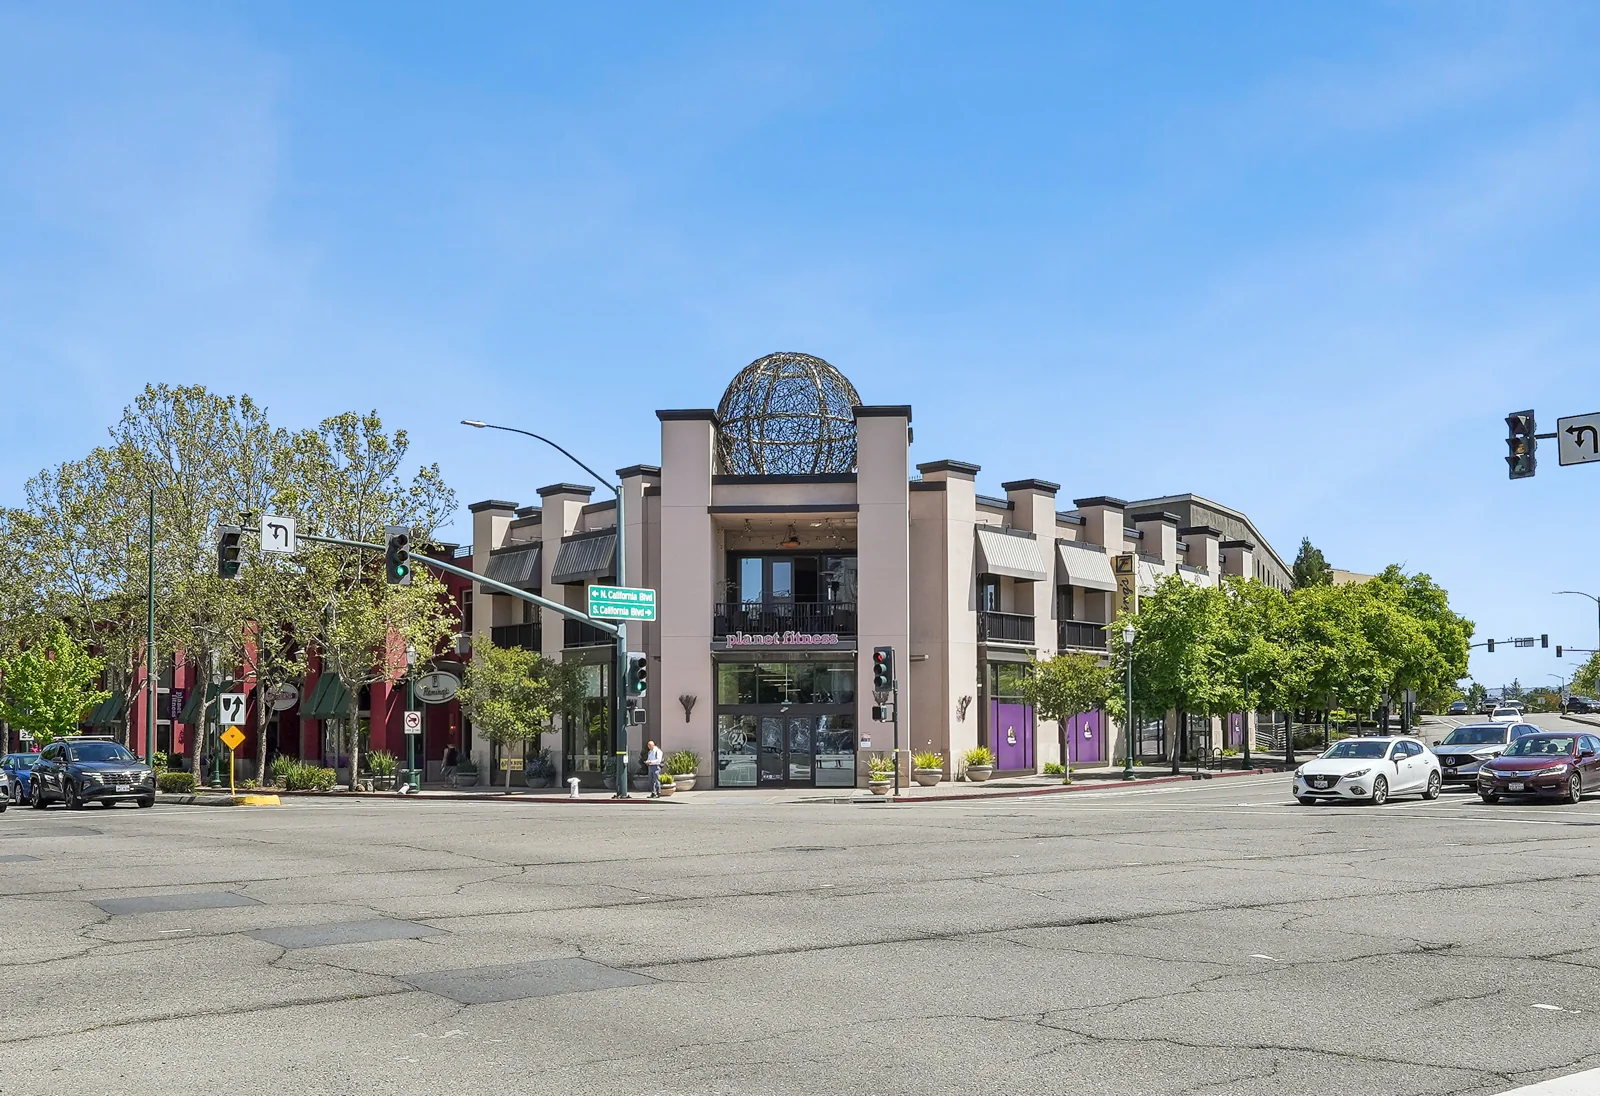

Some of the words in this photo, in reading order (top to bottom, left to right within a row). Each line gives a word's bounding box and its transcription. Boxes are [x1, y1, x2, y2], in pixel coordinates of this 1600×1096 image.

[600, 590, 607, 599] N.
[608, 591, 637, 600] California
[639, 593, 653, 601] Blvd
[593, 605, 599, 614] S.
[600, 606, 629, 615] California
[631, 608, 645, 617] Blvd
[726, 631, 779, 648] planet
[782, 631, 838, 645] fitness
[732, 733, 744, 745] 24
